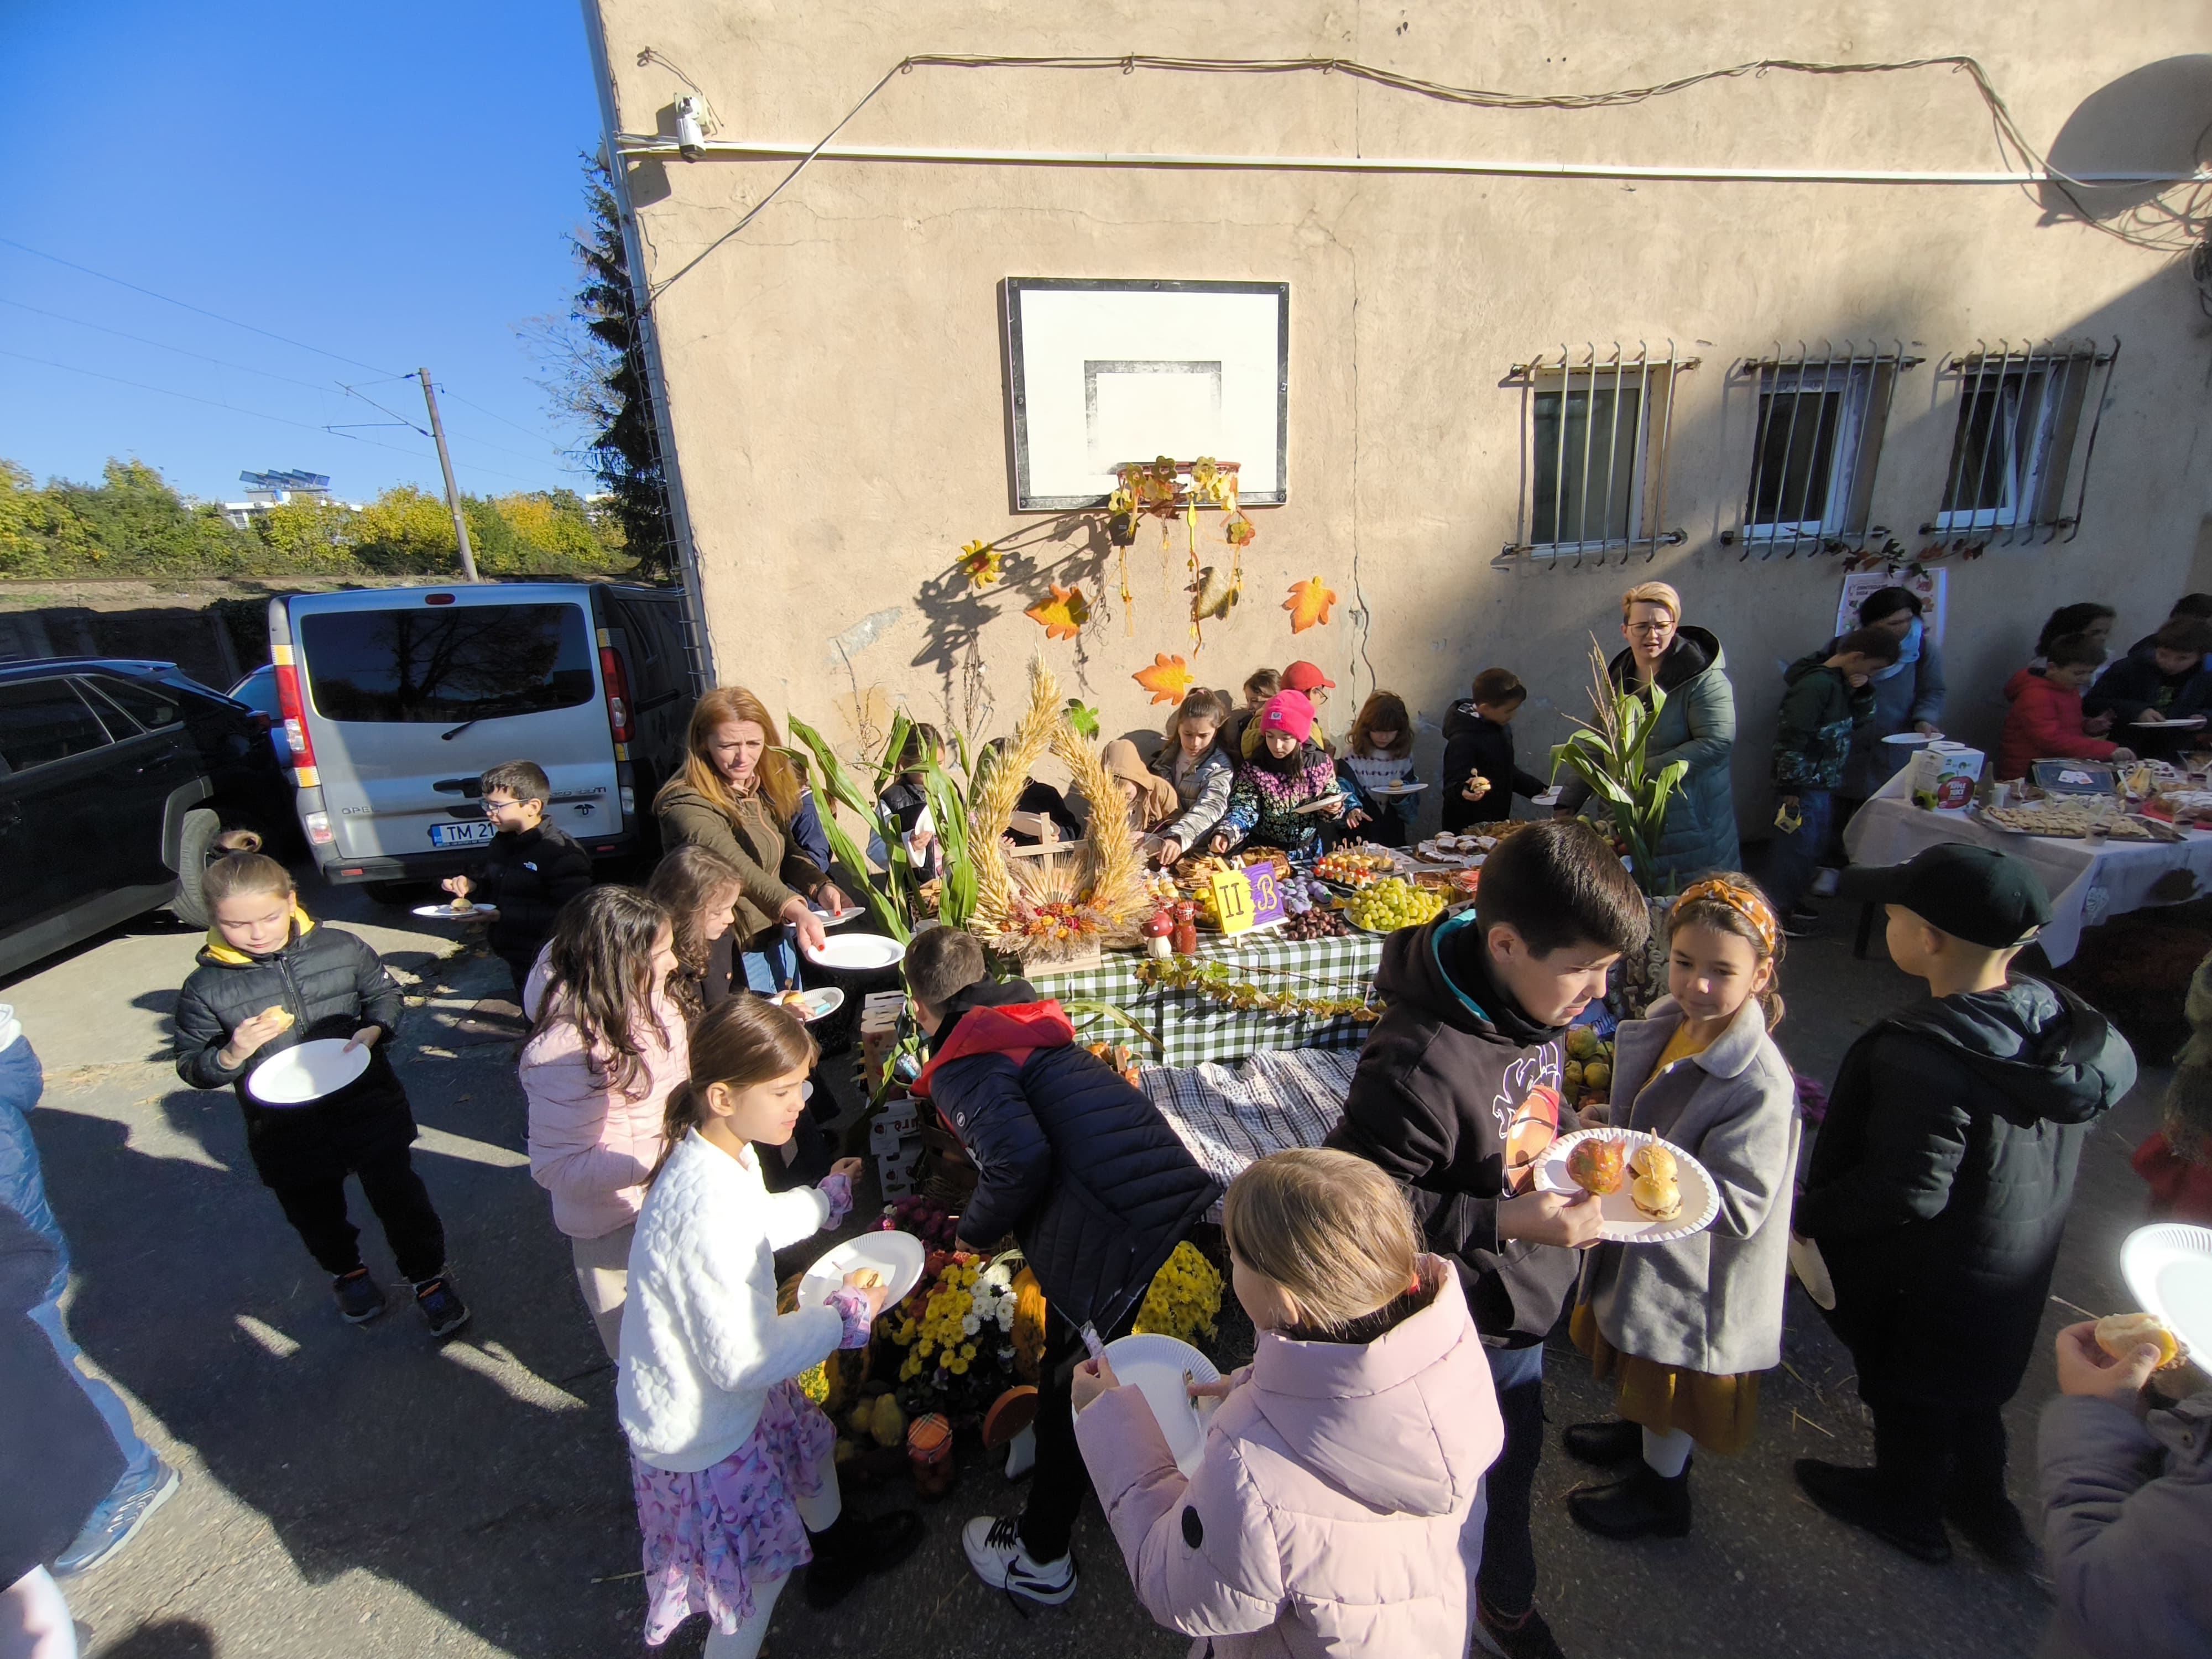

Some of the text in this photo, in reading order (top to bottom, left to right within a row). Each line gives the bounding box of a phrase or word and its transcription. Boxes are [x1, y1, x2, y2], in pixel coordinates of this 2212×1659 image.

[342, 806, 381, 815] OPEL
[447, 824, 472, 841] TM
[1219, 874, 1279, 918] II B
